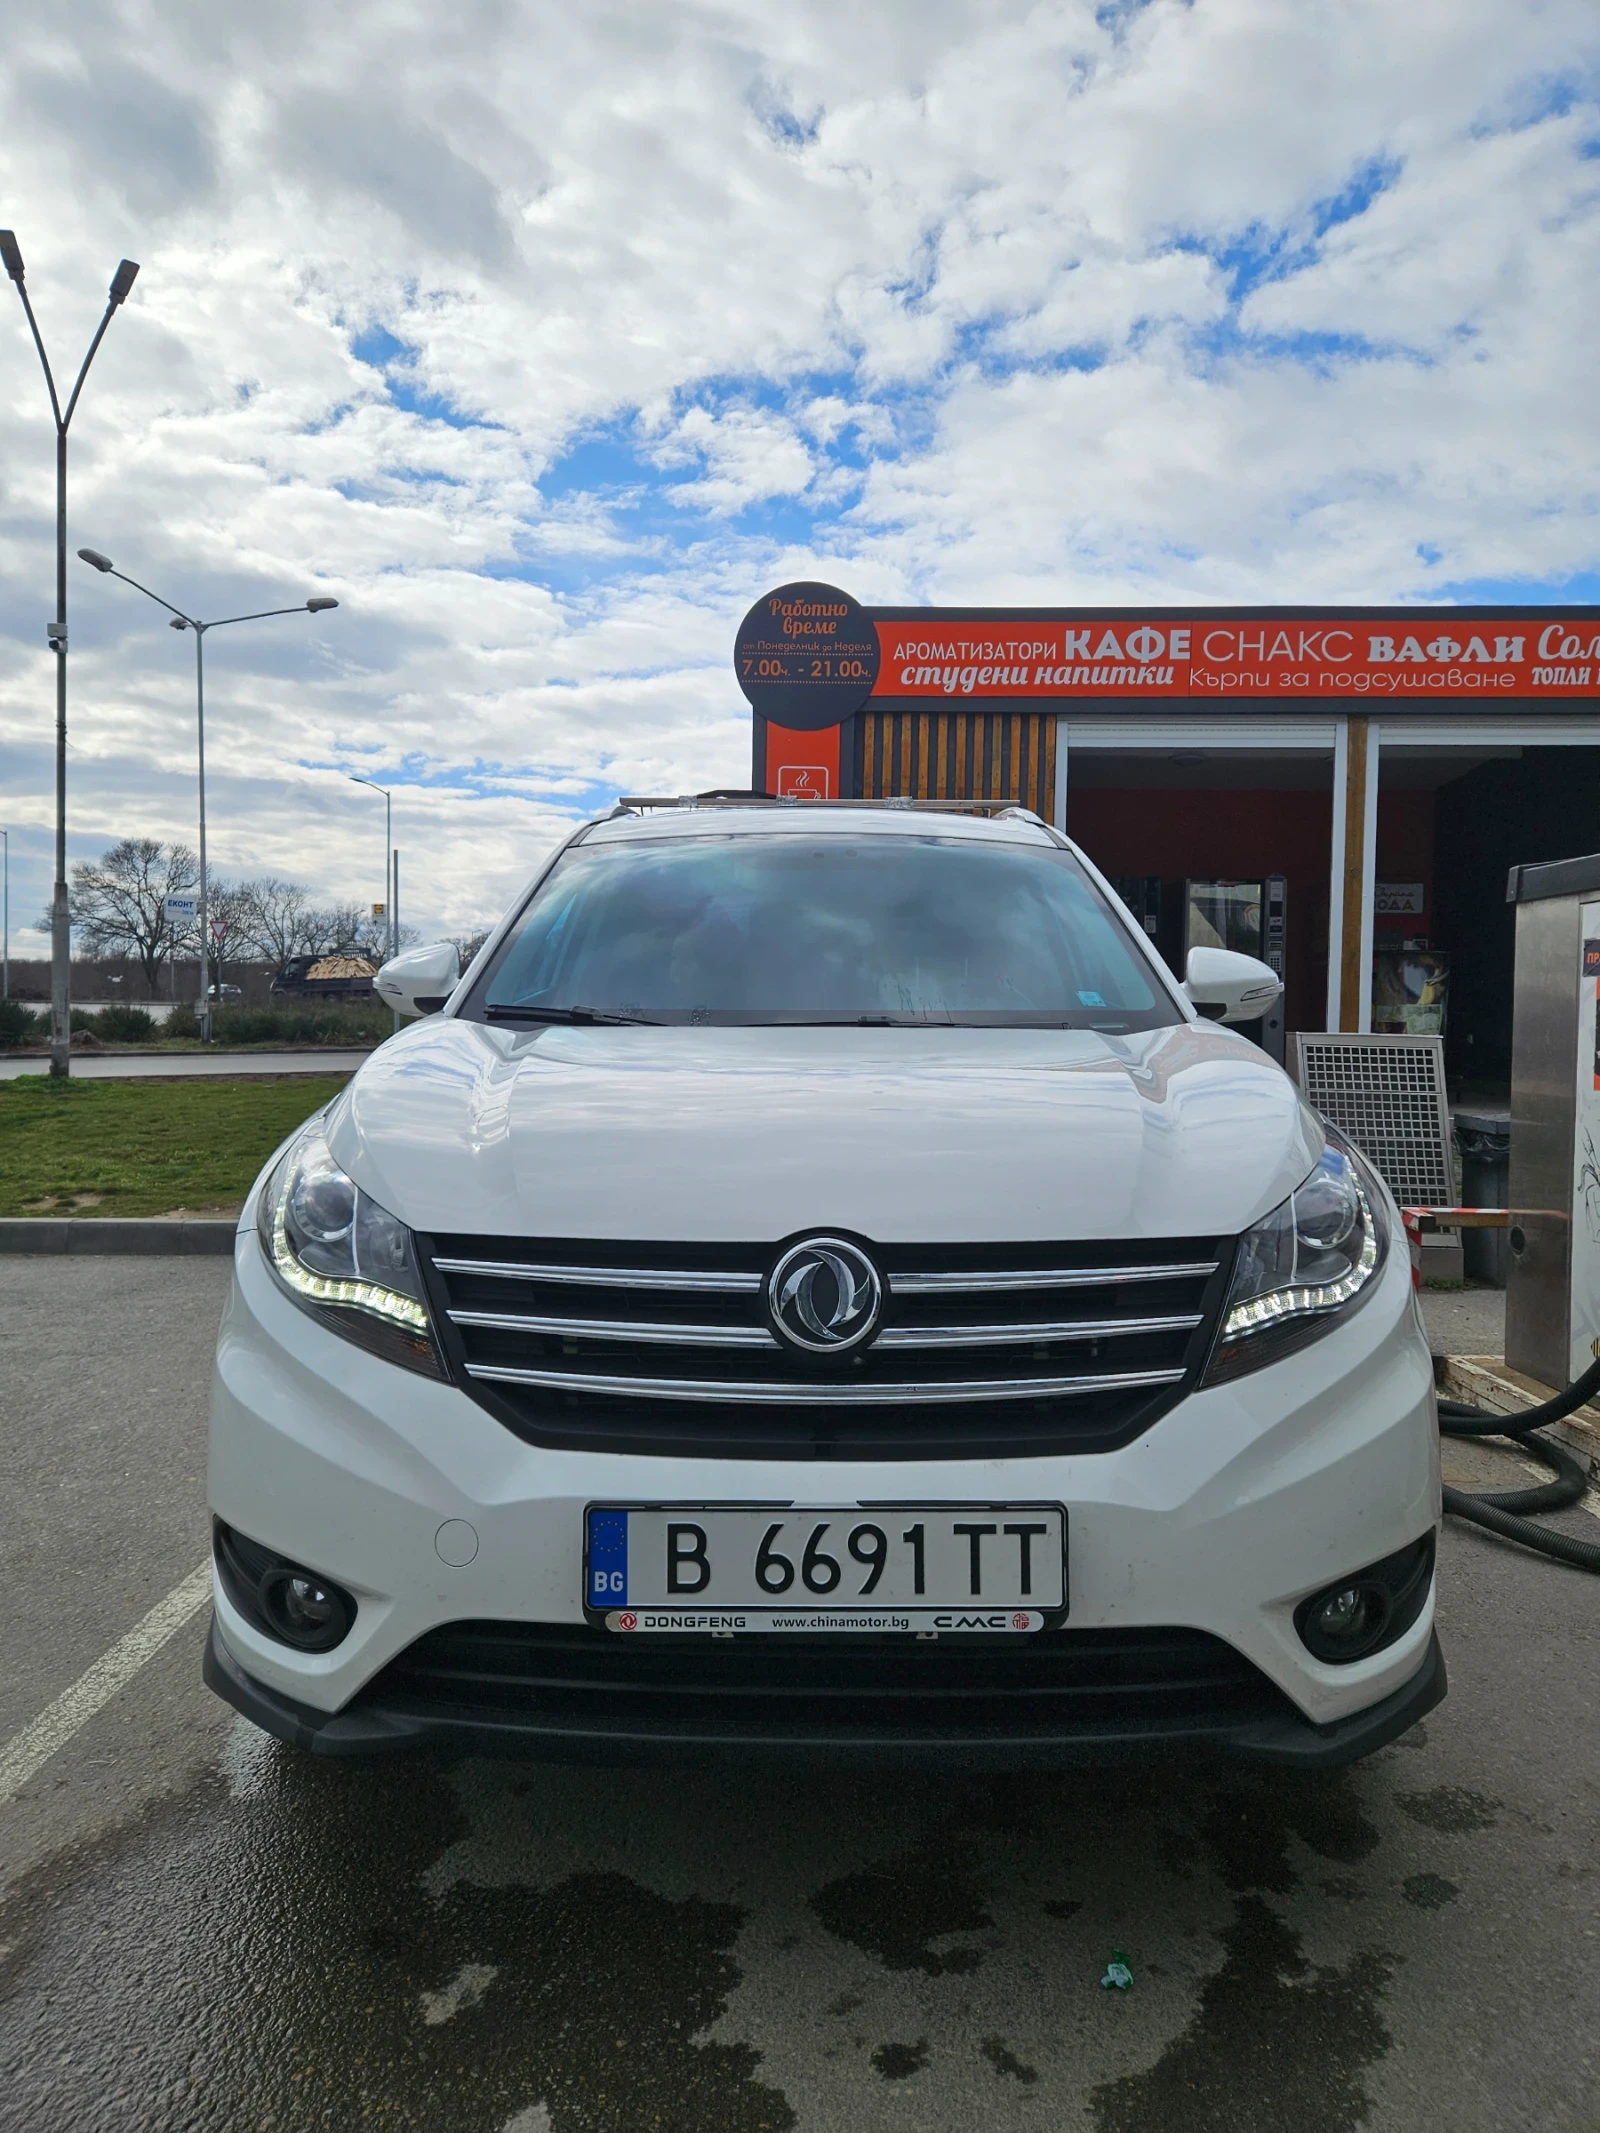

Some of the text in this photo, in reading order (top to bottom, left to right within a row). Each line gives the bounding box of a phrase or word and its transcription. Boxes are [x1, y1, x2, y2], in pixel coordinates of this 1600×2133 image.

[768, 598, 848, 617] Работно
[782, 616, 837, 640] време
[757, 640, 820, 653] Понеделник
[822, 644, 832, 652] до
[834, 641, 872, 653] Неделя
[893, 641, 1056, 660] АРОМАТИЗАТОРИ
[1065, 626, 1191, 663] КАФЕ
[1203, 630, 1353, 662] СНАКС
[1367, 636, 1526, 663] ВАФЛИ
[742, 659, 791, 676] 7.00ч.
[810, 660, 872, 678] 21.00ч.
[900, 664, 1174, 693] студени напитки
[1189, 667, 1270, 691] Кърпи
[1279, 671, 1309, 687] за
[1319, 667, 1517, 692] подсушаване
[167, 899, 194, 908] ЕКОНТ
[1375, 899, 1415, 911] ОДА
[1586, 952, 1600, 964] ПР
[666, 1523, 1048, 1595] B 6691 TT
[594, 1570, 624, 1593] BG
[644, 1616, 1006, 1630] DONGFENG www.chinamotor.bg CMC
